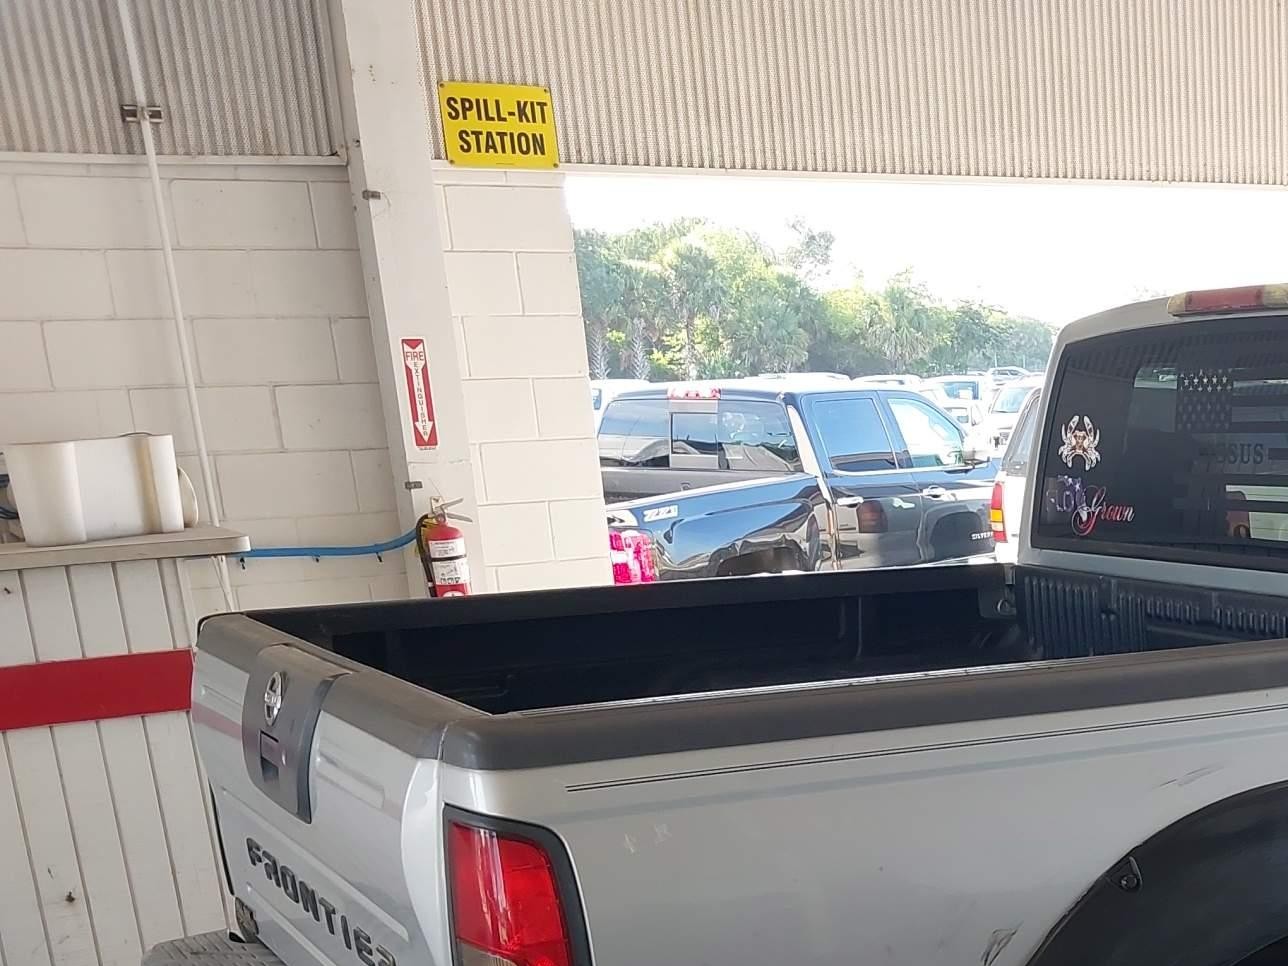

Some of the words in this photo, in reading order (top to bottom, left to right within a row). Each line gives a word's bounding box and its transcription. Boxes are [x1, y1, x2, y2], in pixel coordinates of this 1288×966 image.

[446, 96, 548, 124] SPILL-KIT
[458, 129, 546, 156] STATION
[405, 351, 425, 361] FIRE
[413, 361, 429, 437] EXTINGUISHER
